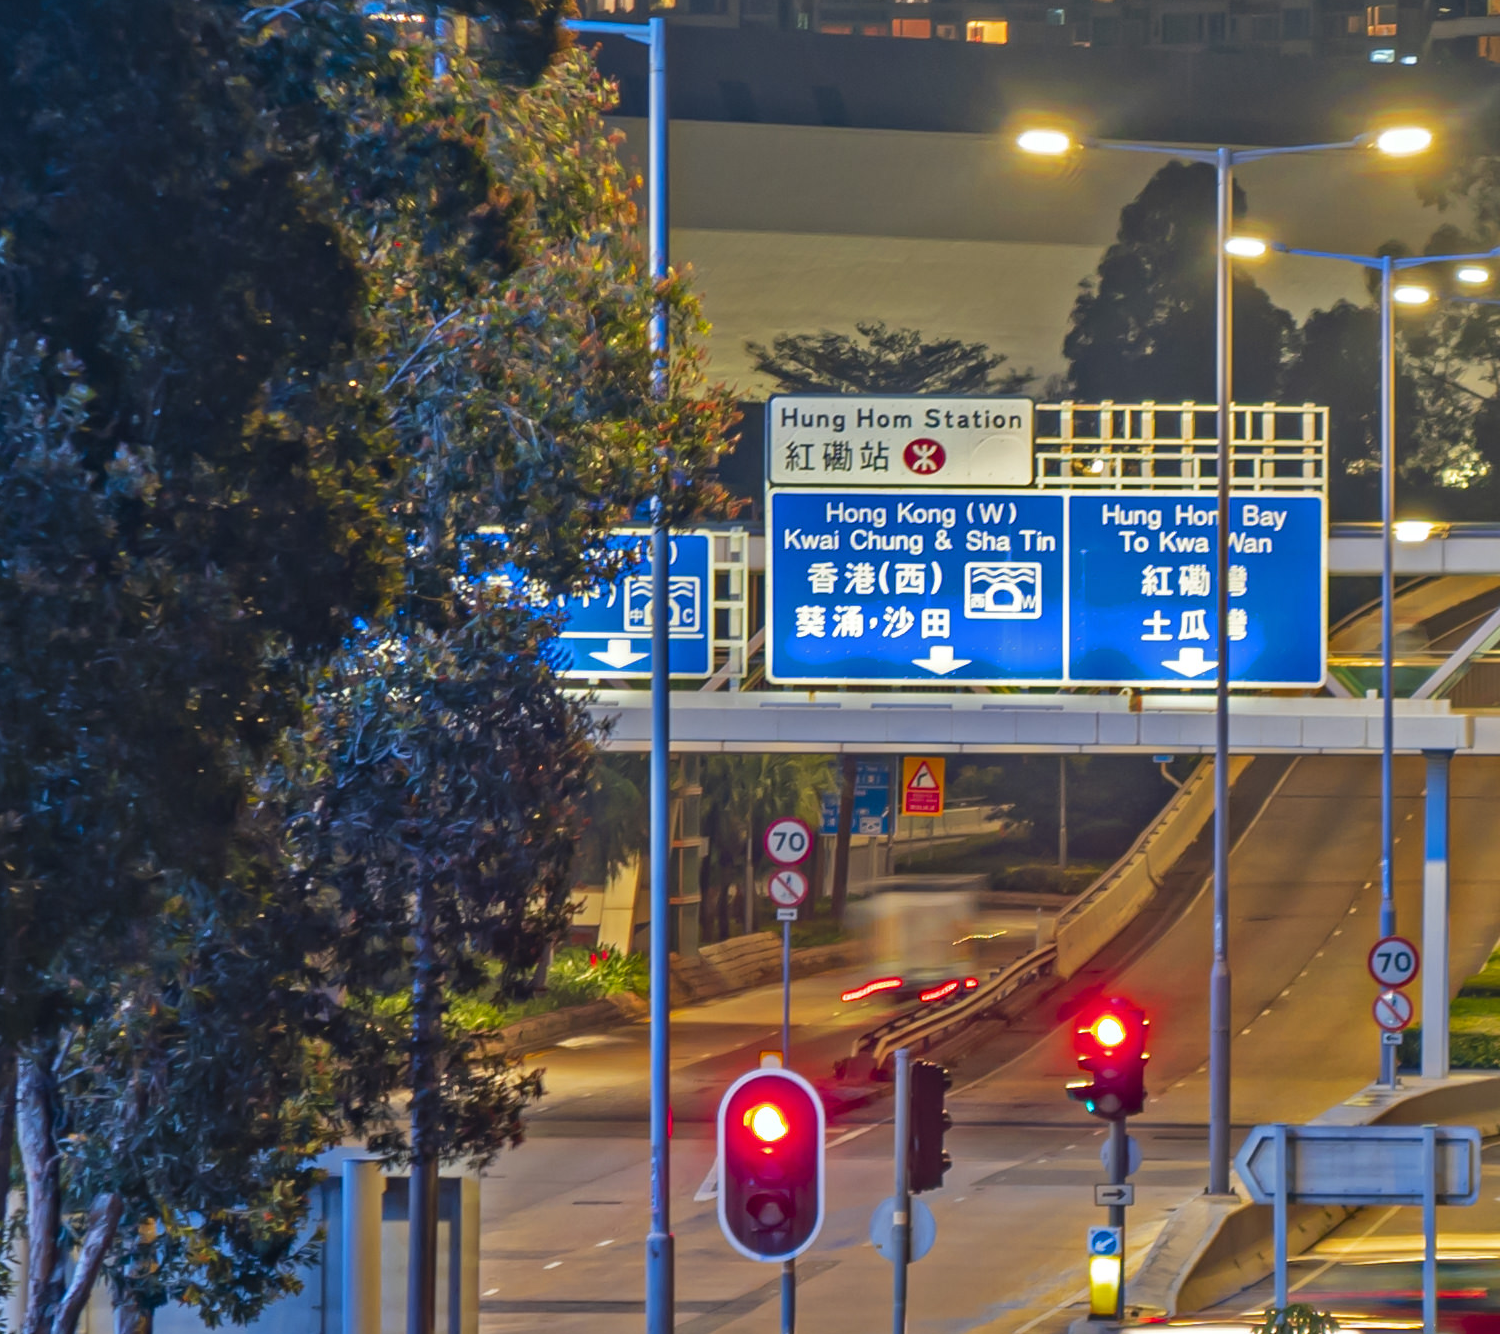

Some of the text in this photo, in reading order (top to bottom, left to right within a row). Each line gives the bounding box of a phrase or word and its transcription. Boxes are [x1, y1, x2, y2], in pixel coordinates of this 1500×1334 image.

[780, 407, 1022, 432] Hung Hom Station
[785, 440, 890, 472] 紅磡站
[826, 502, 1018, 528] Hong Kong (W)
[1101, 503, 1162, 530] Hung
[1242, 505, 1287, 531] Bay
[783, 528, 1056, 555] Kwai Chung & Sha Tin
[1118, 530, 1150, 553] To
[1159, 531, 1210, 553] Kwa
[807, 561, 943, 595] 香港(西)
[682, 608, 694, 624] C
[773, 831, 805, 853] 70
[1377, 951, 1412, 973] 70
